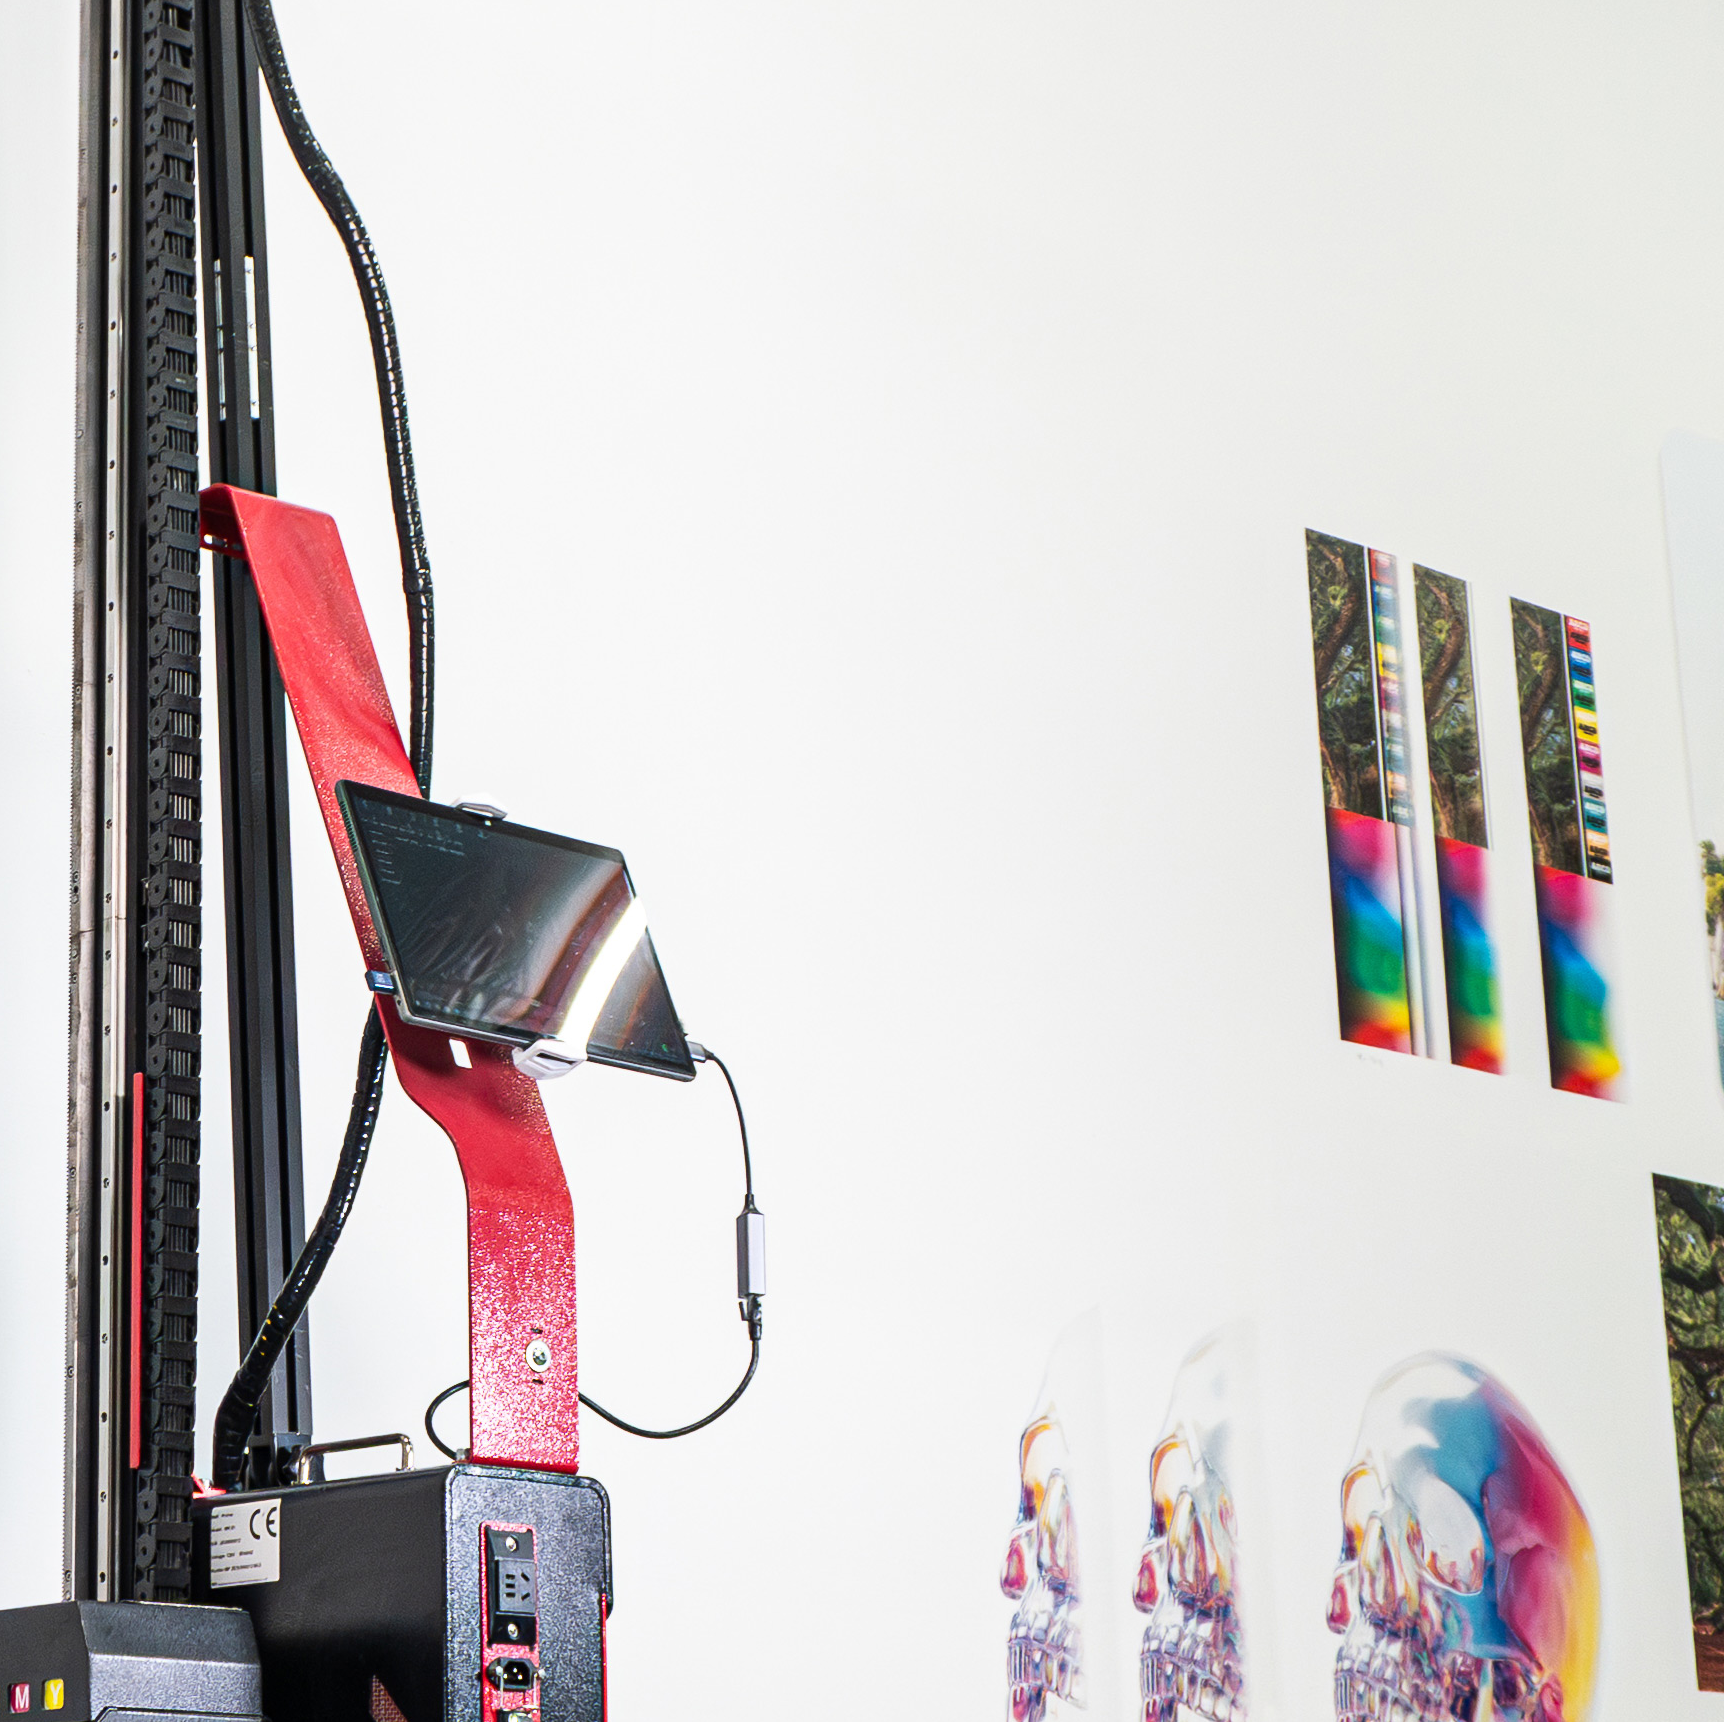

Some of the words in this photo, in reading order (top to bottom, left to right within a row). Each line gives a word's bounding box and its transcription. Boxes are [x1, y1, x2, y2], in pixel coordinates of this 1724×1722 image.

[249, 1506, 277, 1540] CE
[15, 1683, 29, 1710] M
[50, 1682, 62, 1706] Y
